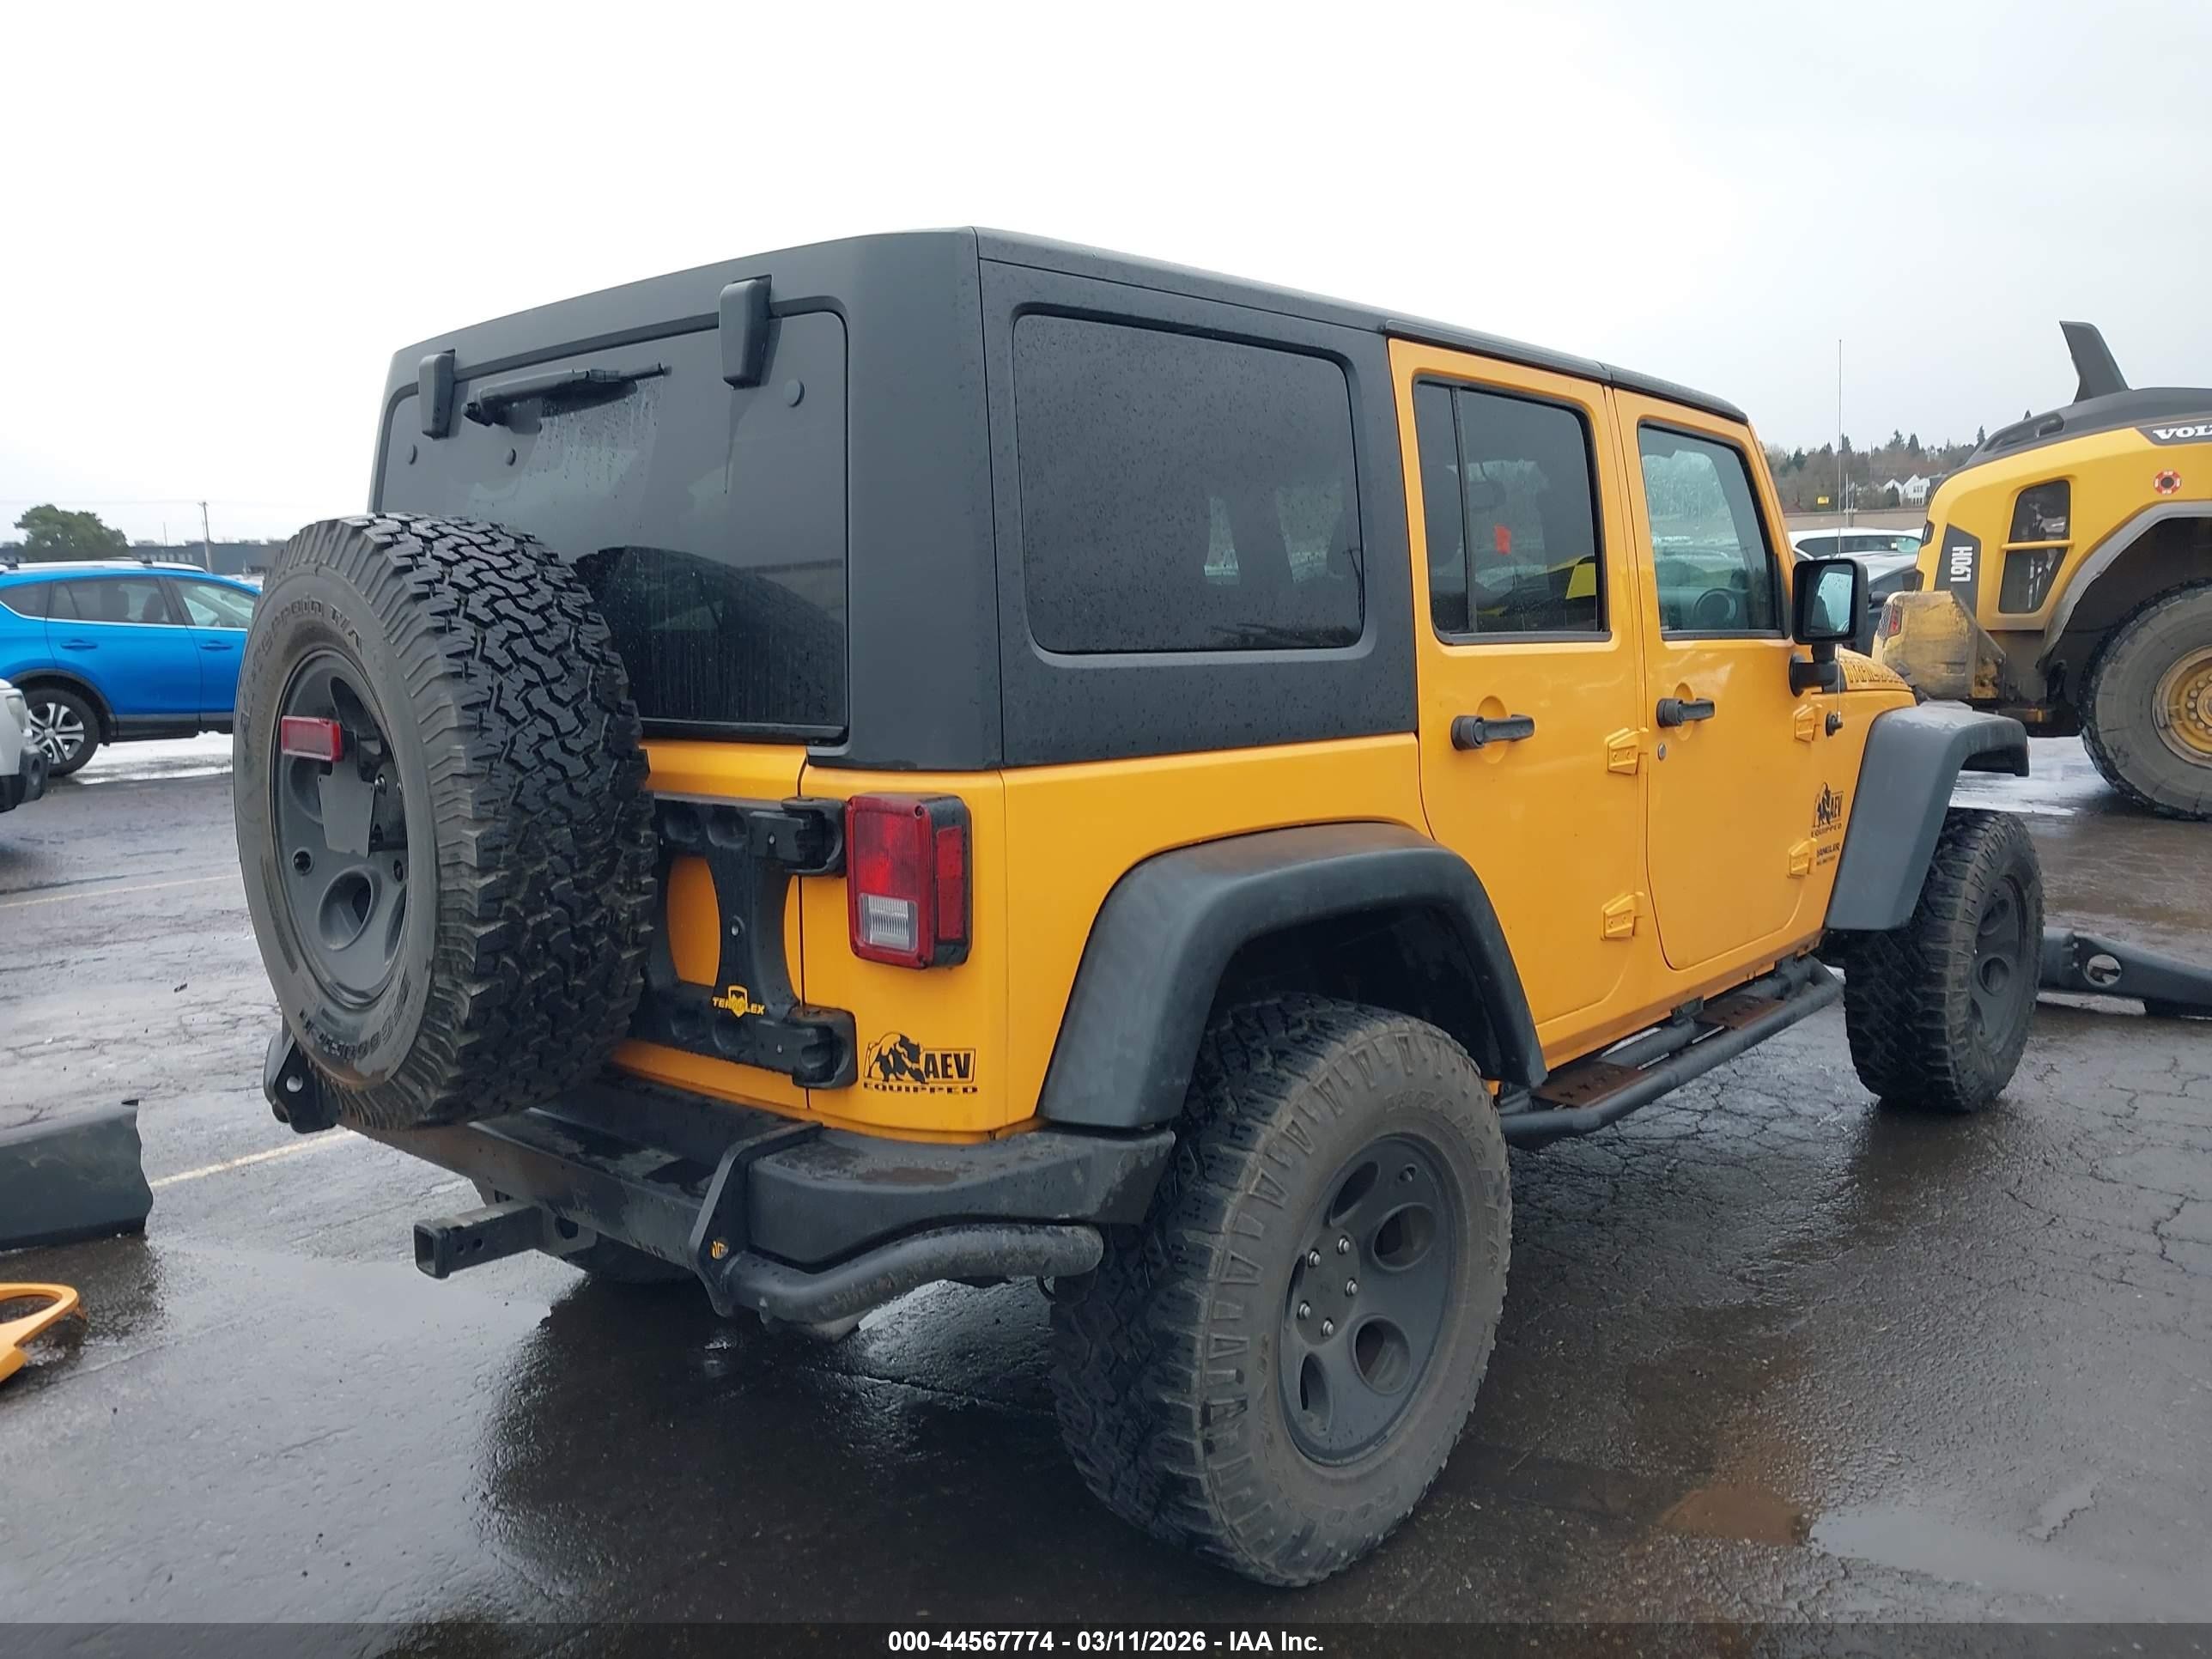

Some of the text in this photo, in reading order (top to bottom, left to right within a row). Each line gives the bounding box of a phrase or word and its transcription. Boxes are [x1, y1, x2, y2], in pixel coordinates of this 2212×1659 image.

[1950, 545, 1973, 582] L90H
[1830, 793, 1844, 818] AEV
[923, 1052, 972, 1079] AEV
[863, 1082, 978, 1095] EQUIPPED
